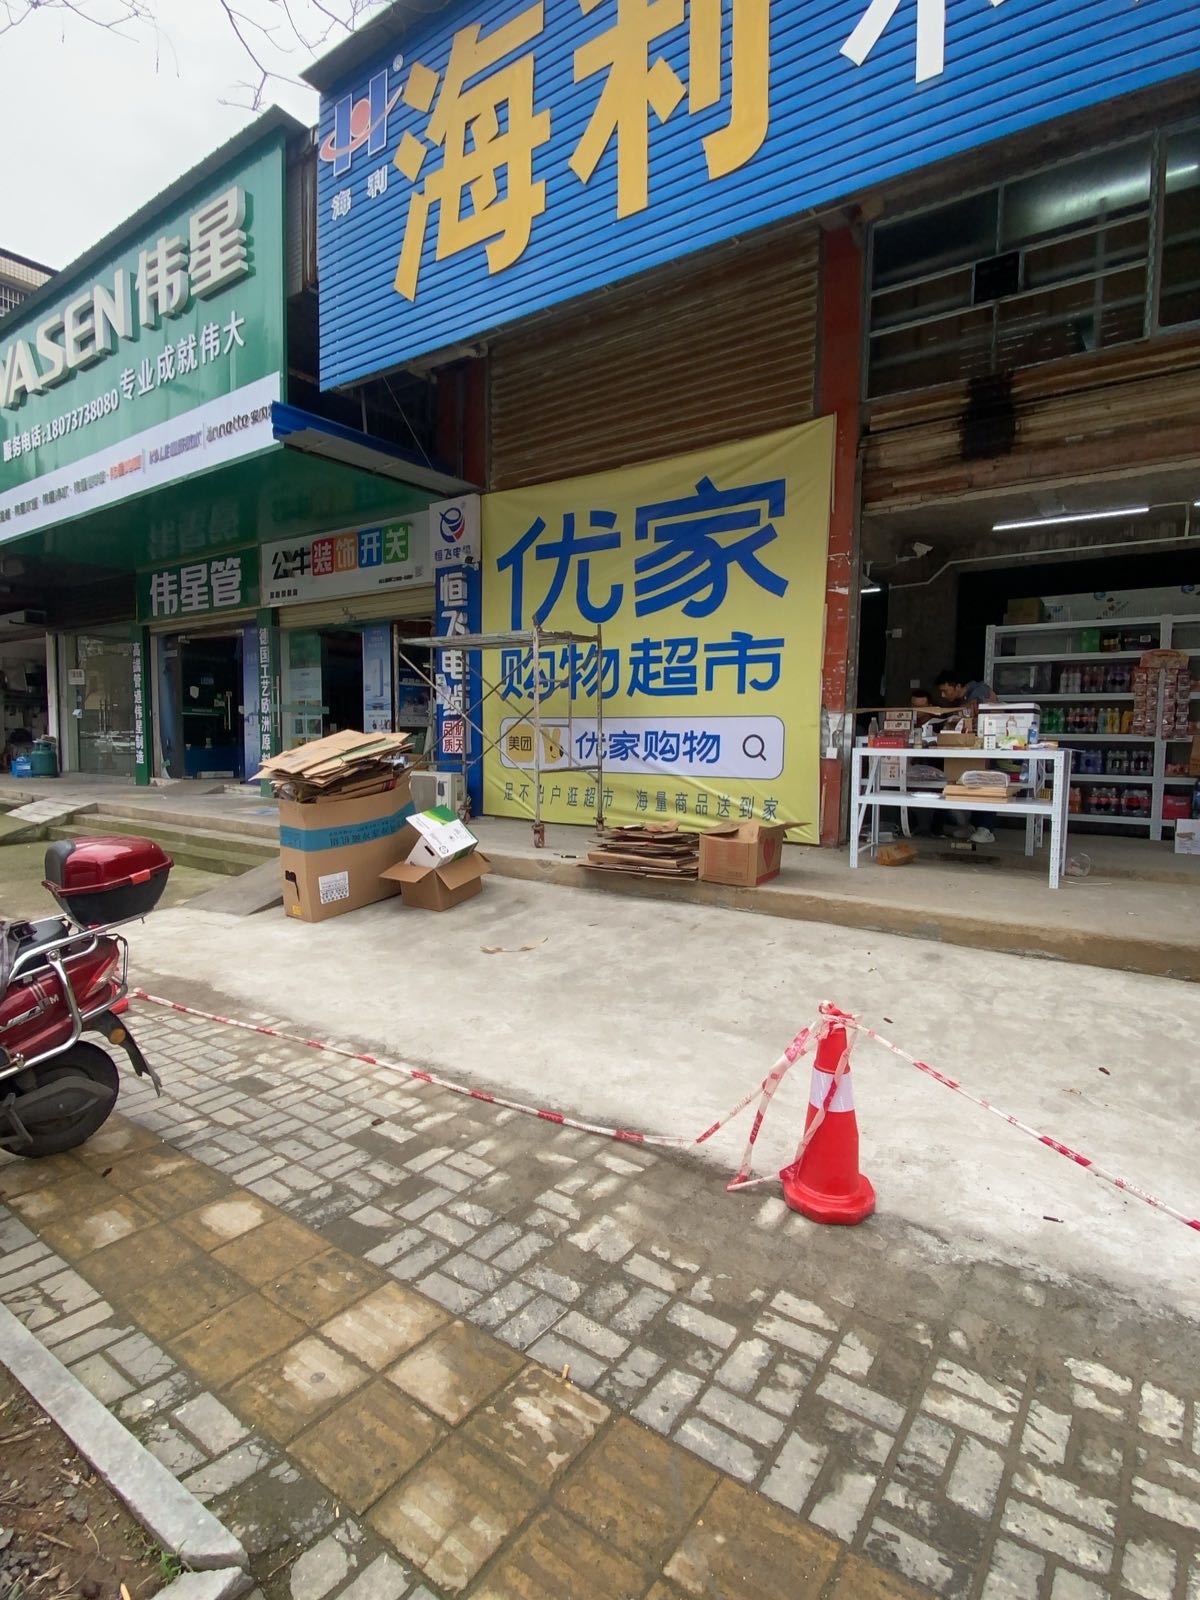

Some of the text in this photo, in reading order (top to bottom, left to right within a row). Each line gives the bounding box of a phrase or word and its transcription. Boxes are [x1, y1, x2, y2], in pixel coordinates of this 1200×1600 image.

[393, 0, 769, 302] 海利
[332, 165, 388, 221] 海利
[135, 186, 248, 328] 伟星
[120, 310, 245, 400] 专业成就伟大
[497, 475, 789, 631] 优家
[149, 557, 242, 617] 伟星管
[501, 632, 785, 702] 购物超市
[508, 735, 532, 752] 美团
[576, 729, 721, 763] 优家购物
[635, 789, 779, 820] 海量商品送到家
